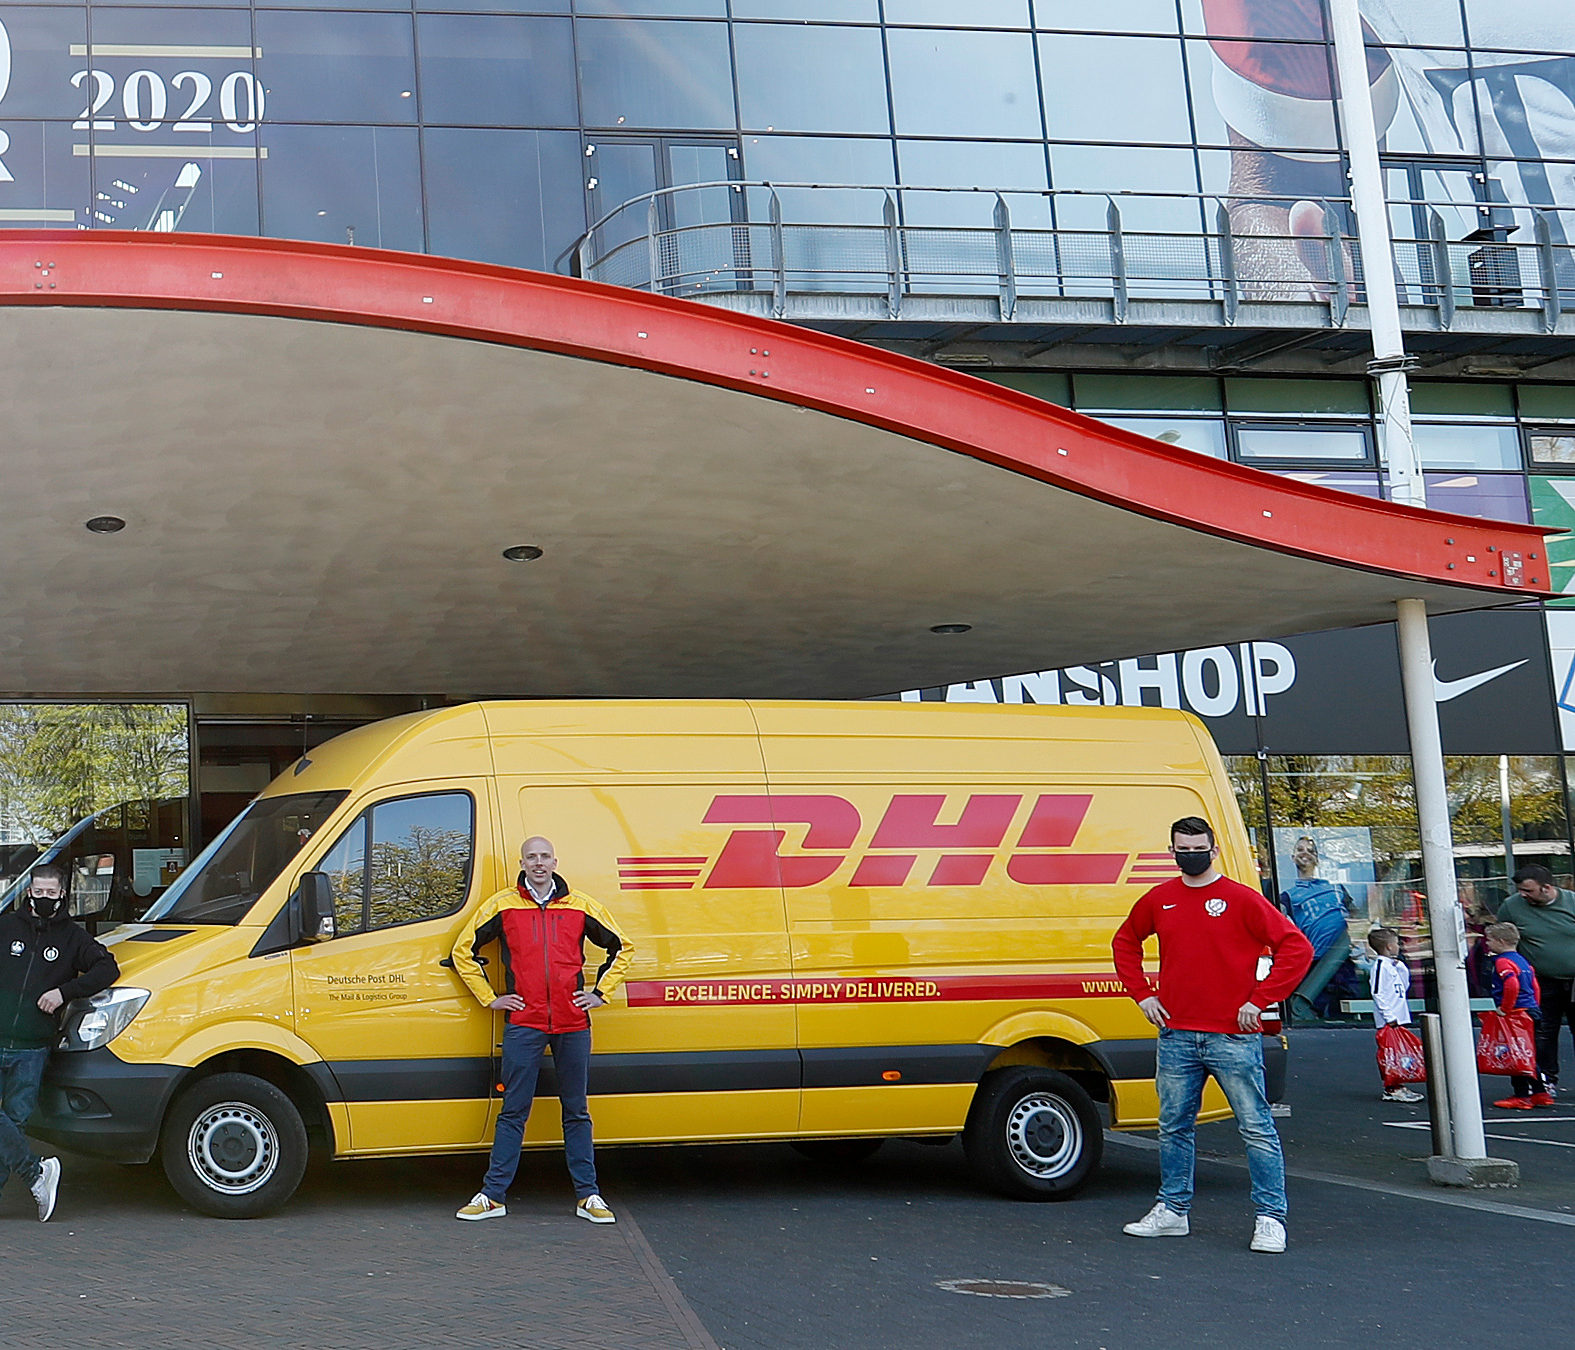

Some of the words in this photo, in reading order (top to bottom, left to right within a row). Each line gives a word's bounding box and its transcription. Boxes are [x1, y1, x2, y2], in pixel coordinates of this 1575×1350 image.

[69, 70, 267, 133] 2020
[701, 794, 1129, 889] DHL
[327, 975, 366, 985] Deutsche
[368, 974, 386, 984] Post
[389, 974, 406, 984] DHL
[341, 993, 355, 1001] Mail
[362, 993, 388, 1002] Logistics
[389, 993, 408, 1001] Group
[664, 984, 777, 1001] EXCELLENCE.
[780, 983, 842, 999] SIMPLY
[845, 981, 941, 998] DELIVERED.
